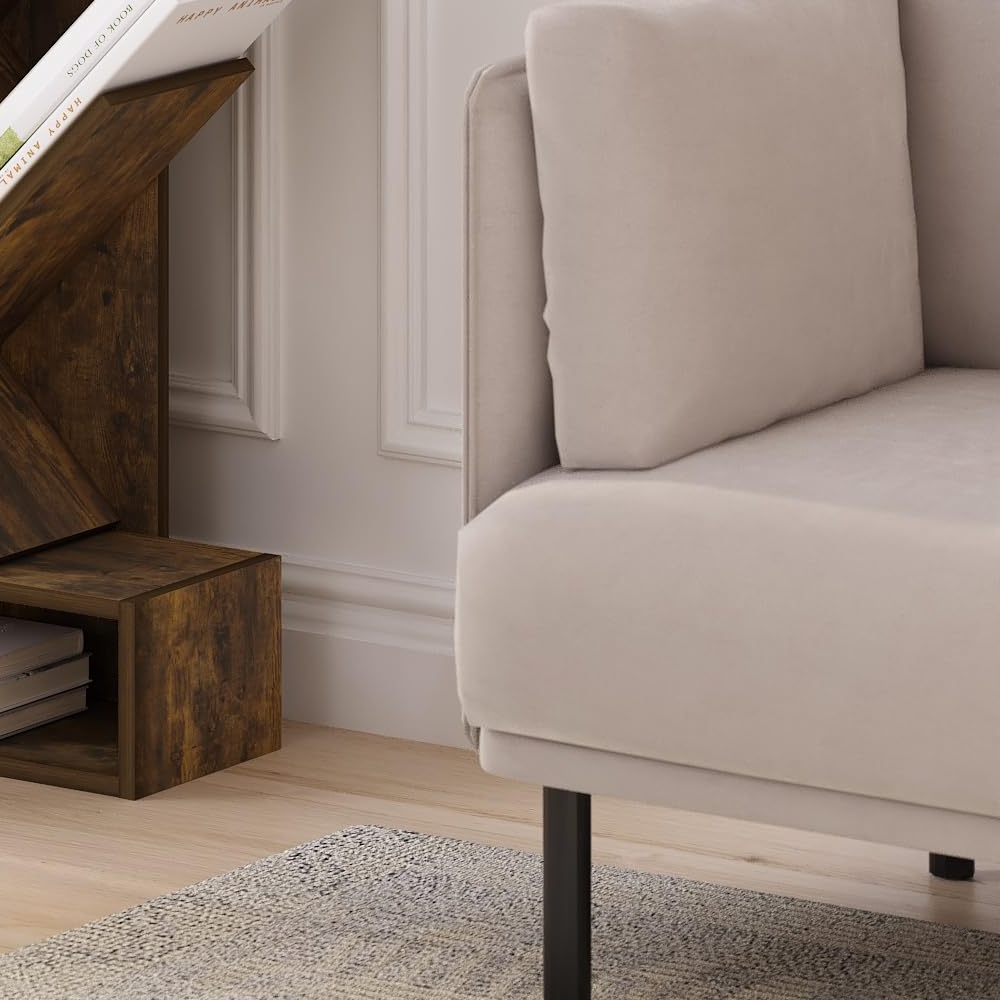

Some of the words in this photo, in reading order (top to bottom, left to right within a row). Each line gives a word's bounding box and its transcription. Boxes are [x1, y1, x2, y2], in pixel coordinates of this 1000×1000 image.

[108, 4, 133, 34] BOOK
[176, 6, 223, 24] HAPPY
[94, 34, 106, 48] OF
[67, 48, 93, 77] DOGS
[48, 96, 82, 137] HAPPY
